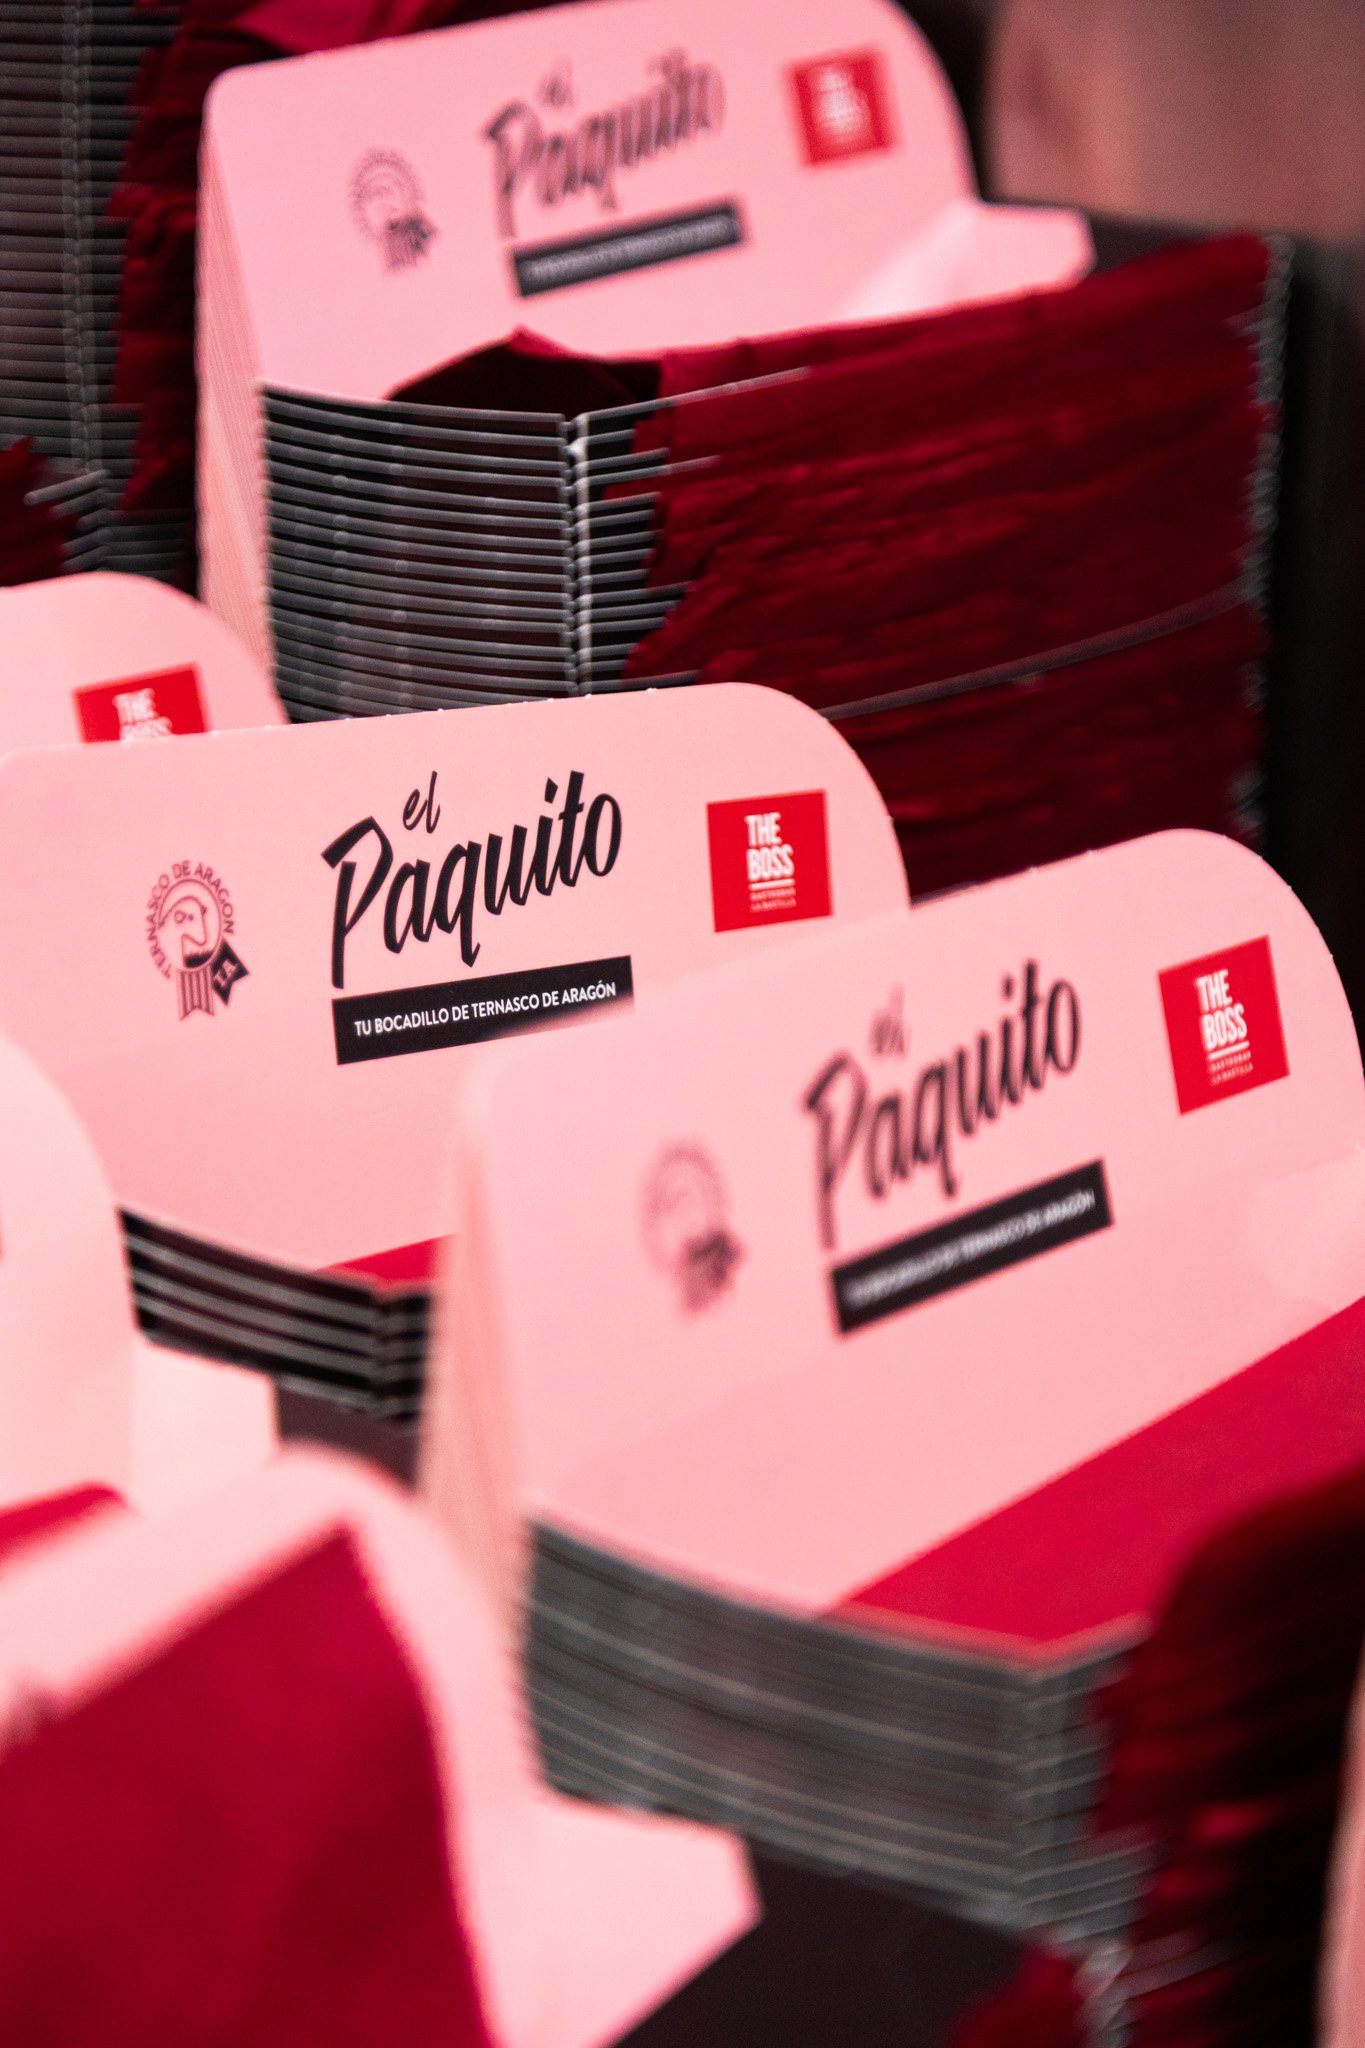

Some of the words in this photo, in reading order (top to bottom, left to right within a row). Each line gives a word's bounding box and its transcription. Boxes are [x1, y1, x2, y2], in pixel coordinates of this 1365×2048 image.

[482, 49, 727, 239] Paquito
[402, 771, 441, 834] el
[745, 812, 783, 845] THE
[321, 770, 622, 989] Paquito
[747, 844, 795, 881] BOSS
[145, 873, 172, 980] TERNASCO
[171, 859, 191, 879] DE
[354, 1020, 372, 1037] TU
[374, 1007, 449, 1033] BOCADILLO
[451, 1004, 470, 1021] DE
[471, 993, 539, 1018] TERNASCO
[542, 990, 560, 1006] DE
[561, 980, 617, 1004] ARAGÓN
[1196, 968, 1233, 1012] THE
[1202, 1003, 1248, 1051] BOSS
[804, 959, 1083, 1250] Paquito
